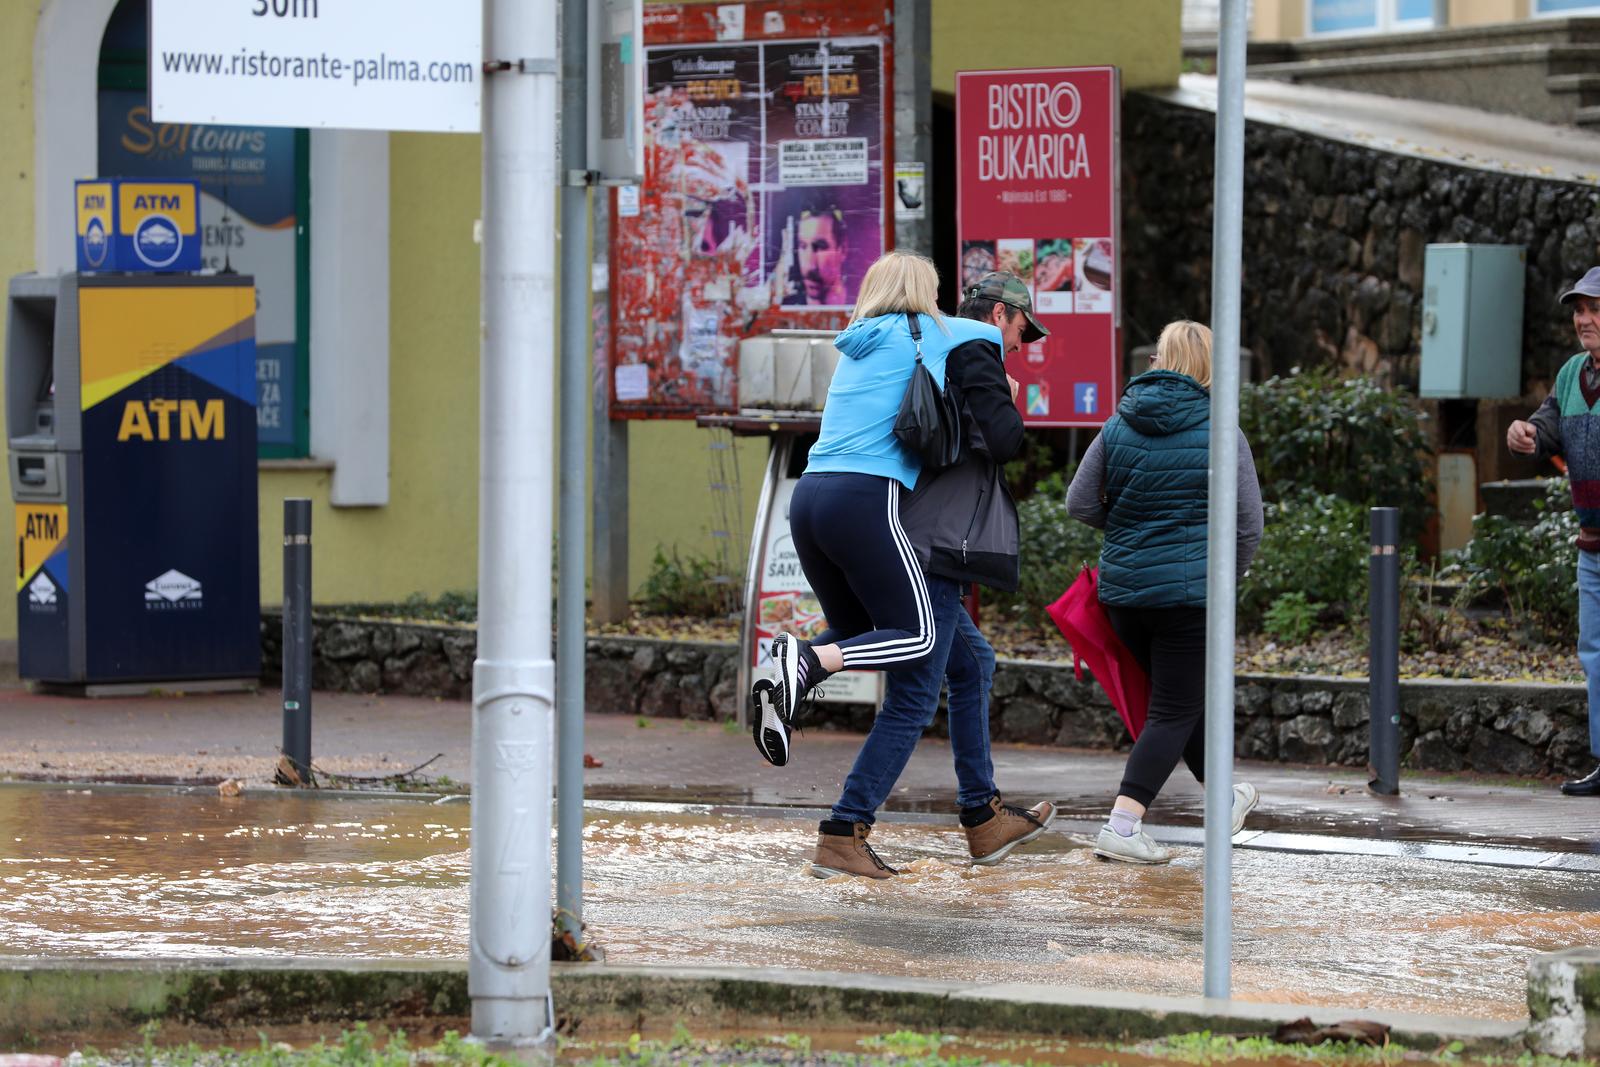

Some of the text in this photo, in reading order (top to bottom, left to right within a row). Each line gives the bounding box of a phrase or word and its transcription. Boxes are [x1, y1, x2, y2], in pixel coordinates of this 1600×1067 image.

[163, 48, 474, 86] www.ristorante-palma.com
[988, 81, 1082, 129] BISTRO
[978, 133, 1091, 181] BUKARICA
[84, 194, 105, 209] ATM
[134, 195, 180, 210] ATM
[202, 224, 244, 247] ENTS
[118, 399, 225, 441] ATM
[26, 513, 59, 539] ATM
